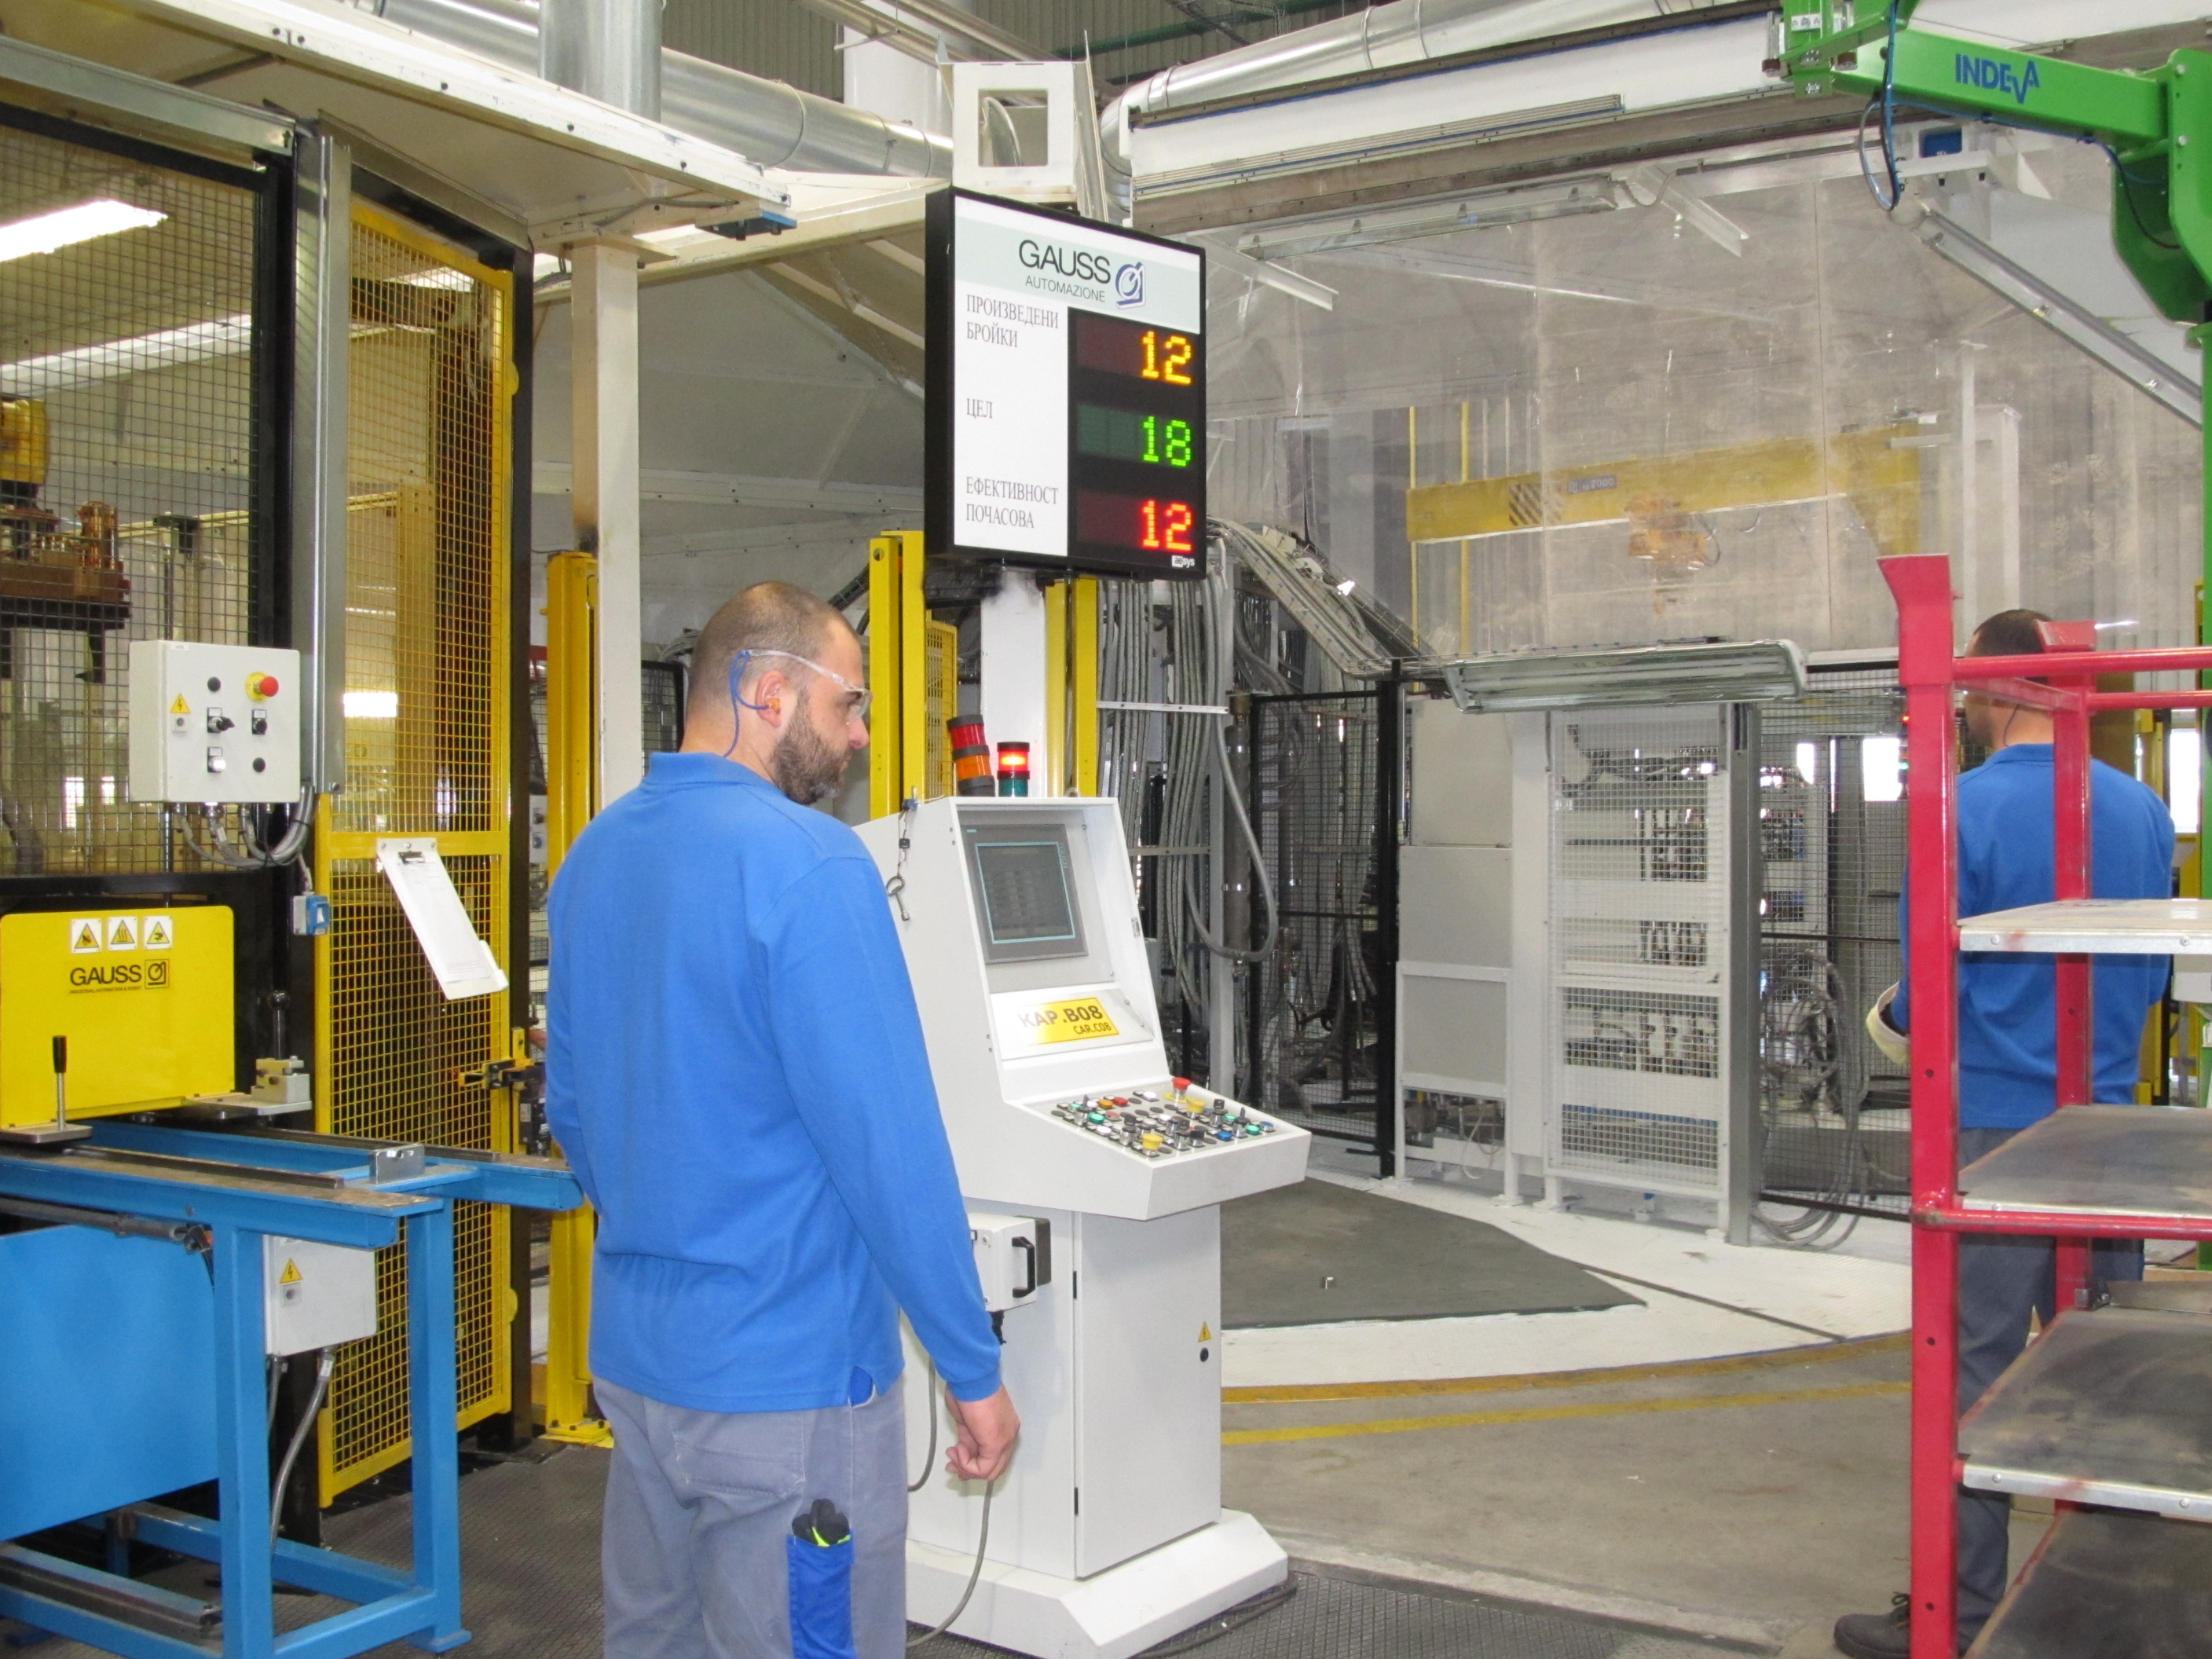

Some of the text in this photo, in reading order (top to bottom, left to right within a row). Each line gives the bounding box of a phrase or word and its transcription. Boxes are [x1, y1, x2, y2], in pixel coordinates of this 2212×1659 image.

[1955, 53, 2040, 104] INDEVA
[1019, 239, 1111, 284] GAUSS
[1025, 275, 1106, 302] AUTOMAZIONE
[966, 294, 1059, 329] ПРОИЗВЕДЕНИ
[966, 321, 1018, 348] БРОЙКИ
[1142, 330, 1192, 385] 12
[966, 397, 993, 420] ЦЕЛ
[1143, 416, 1192, 467] 18
[966, 476, 1059, 505] ЕФЕКТИВНОСТ
[966, 504, 1035, 529] ПОЧАСОВА
[1142, 500, 1192, 552] 12
[1174, 556, 1196, 569] aesys
[70, 965, 142, 986] GAUSS
